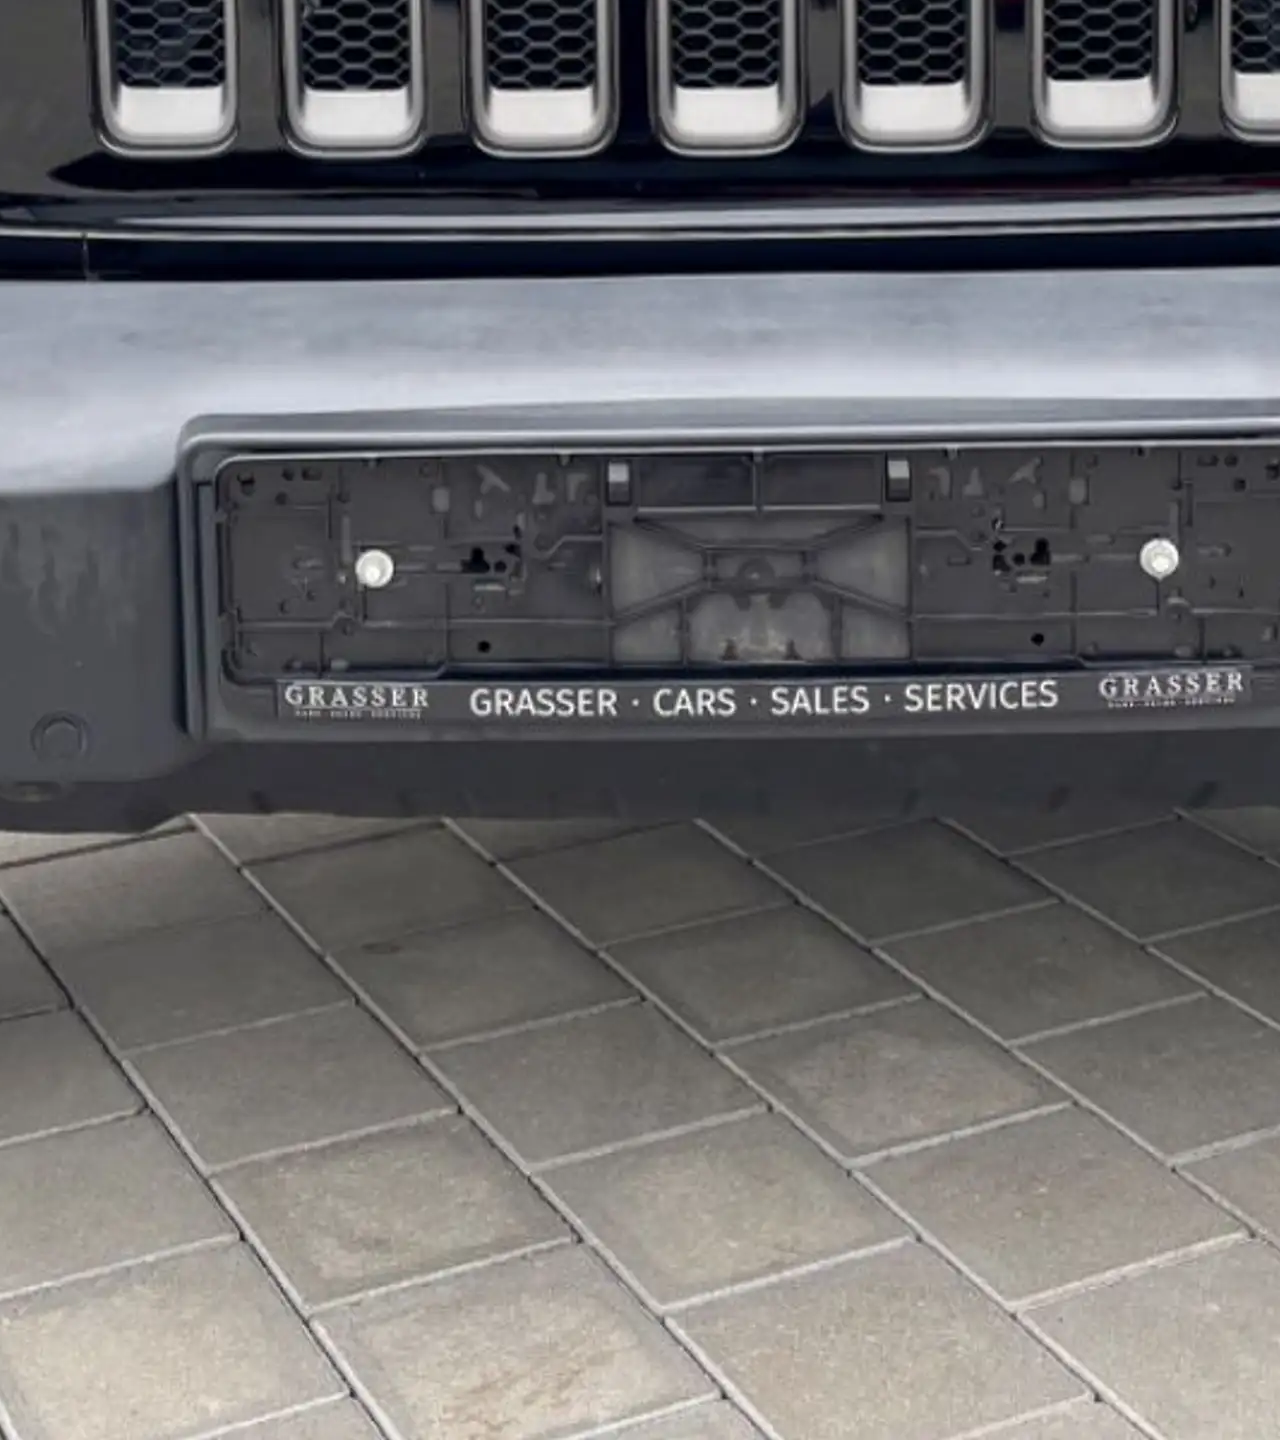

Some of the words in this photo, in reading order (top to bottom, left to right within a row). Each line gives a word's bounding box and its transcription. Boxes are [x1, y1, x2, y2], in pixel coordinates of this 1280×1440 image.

[284, 684, 430, 708] GRASSER
[1098, 671, 1244, 698] GRASSER
[469, 687, 619, 718] GRASSER
[652, 687, 737, 717] CARS
[770, 684, 870, 716] SALES
[903, 679, 1059, 711] SERVICES
